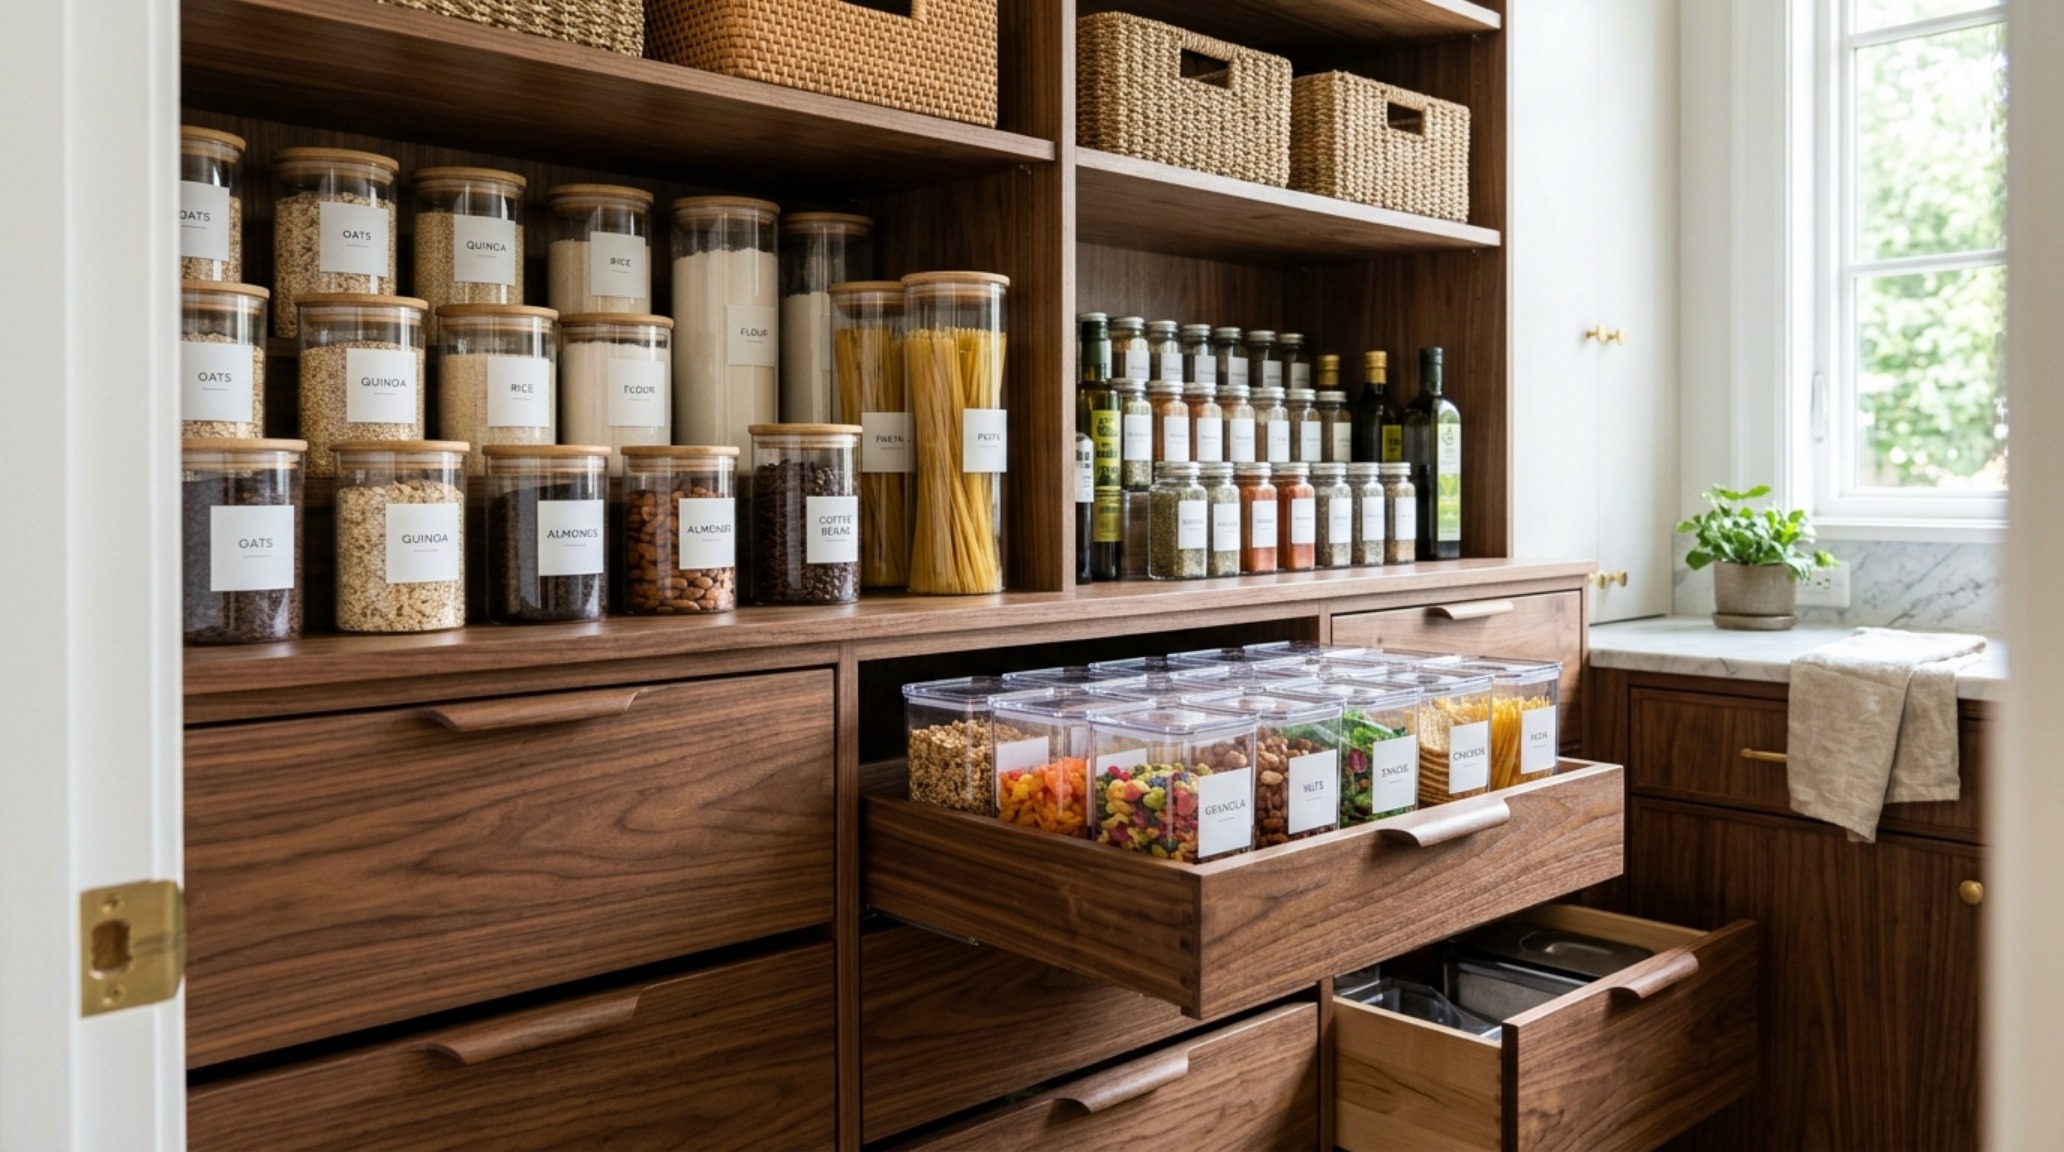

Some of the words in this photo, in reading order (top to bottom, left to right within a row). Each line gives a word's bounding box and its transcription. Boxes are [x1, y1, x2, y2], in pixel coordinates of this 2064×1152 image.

[342, 230, 372, 241] OATS
[198, 372, 232, 383] OATS
[361, 376, 407, 387] QUINOA
[238, 538, 273, 549] OATS
